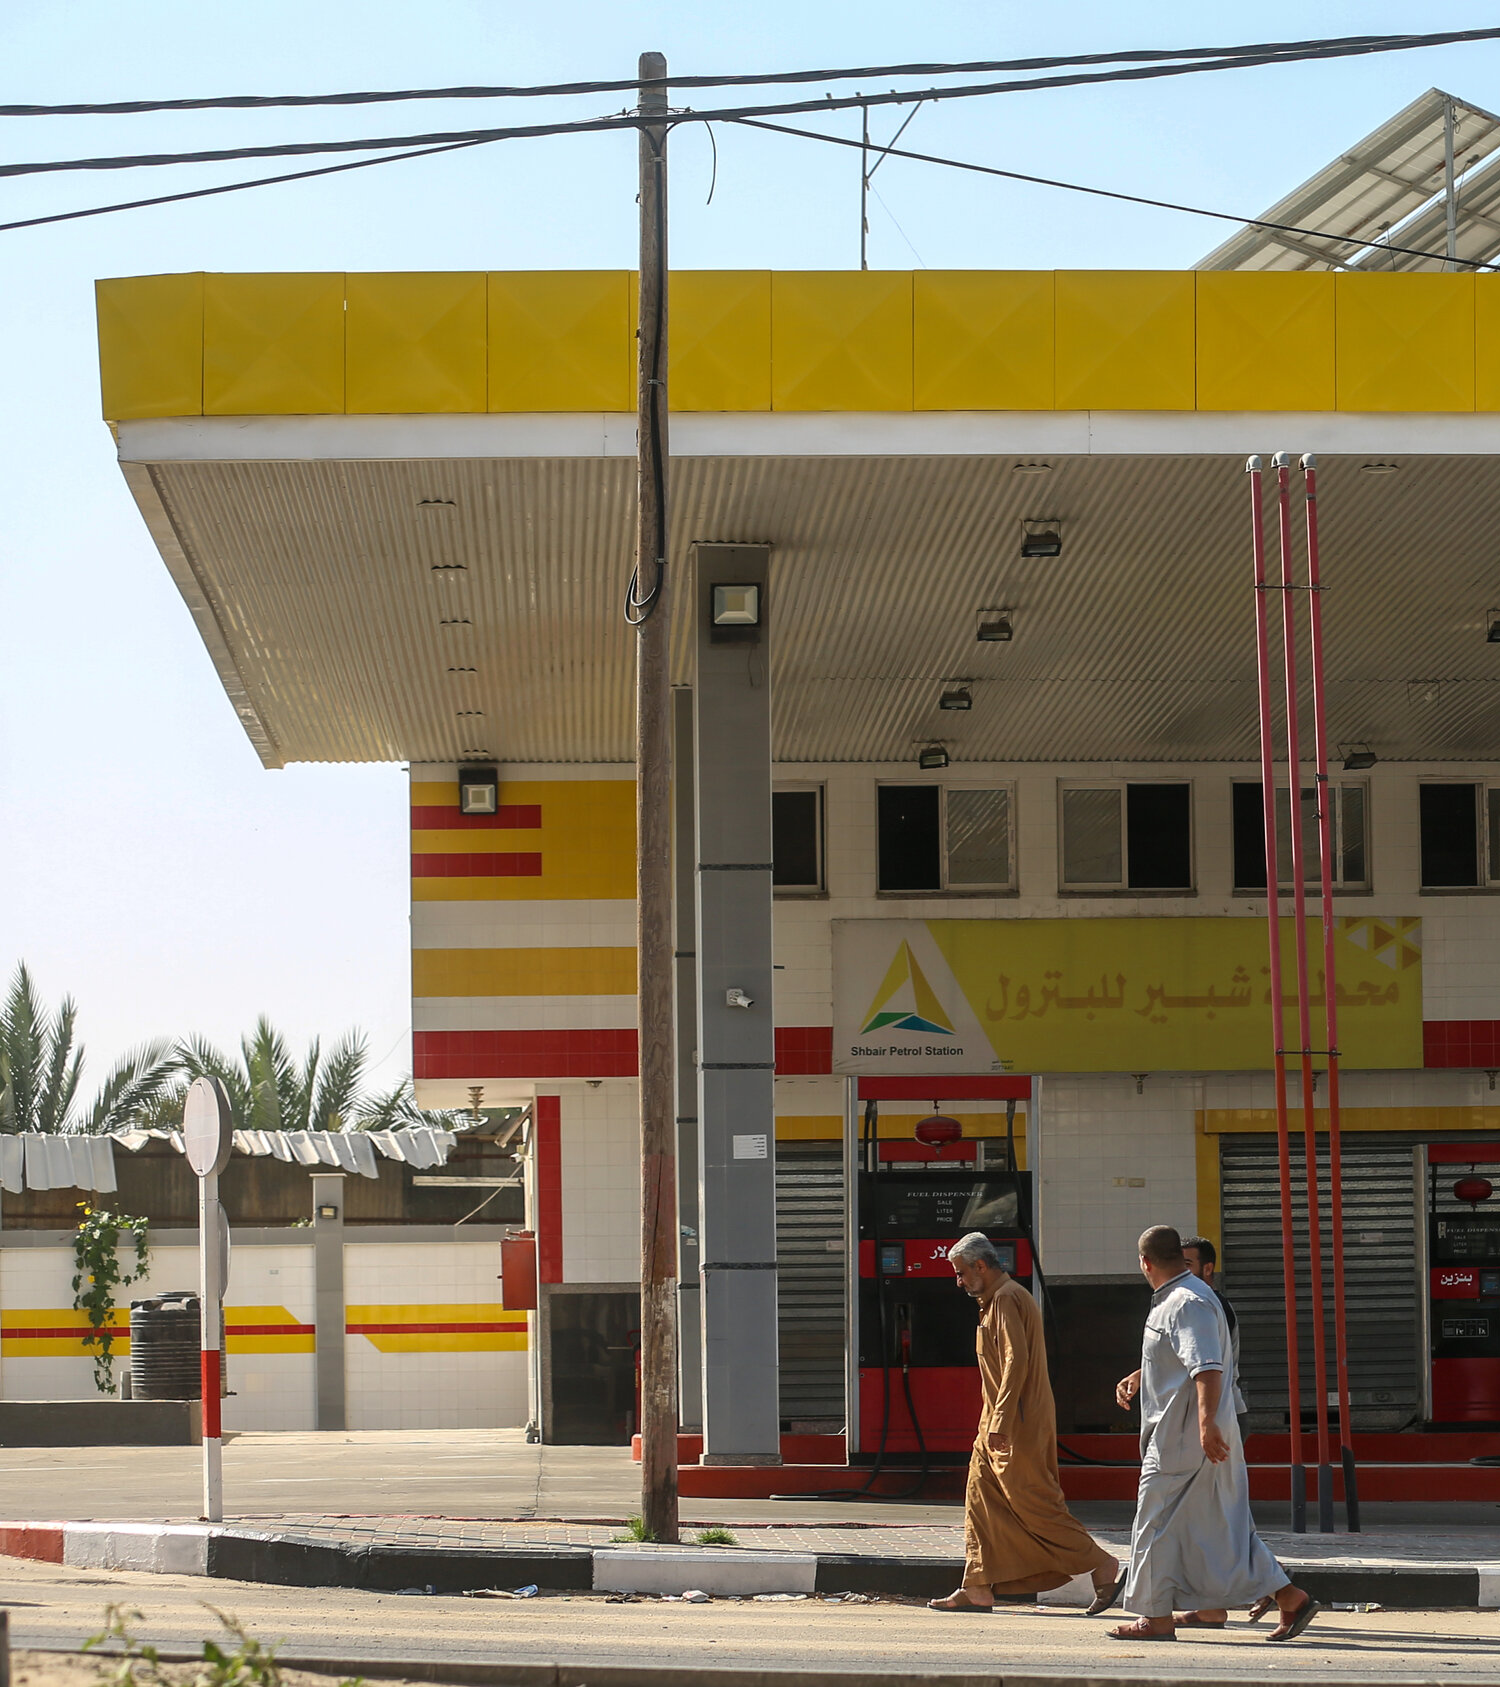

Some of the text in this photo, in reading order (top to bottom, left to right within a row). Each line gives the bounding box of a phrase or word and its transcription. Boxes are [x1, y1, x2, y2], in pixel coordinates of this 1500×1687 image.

[986, 970, 1127, 1022] للبترول
[1134, 965, 1251, 1024] شبير
[851, 1046, 964, 1056] Shbair Petrol Station
[929, 1245, 951, 1262] لار
[1440, 1272, 1473, 1286] بنزين
